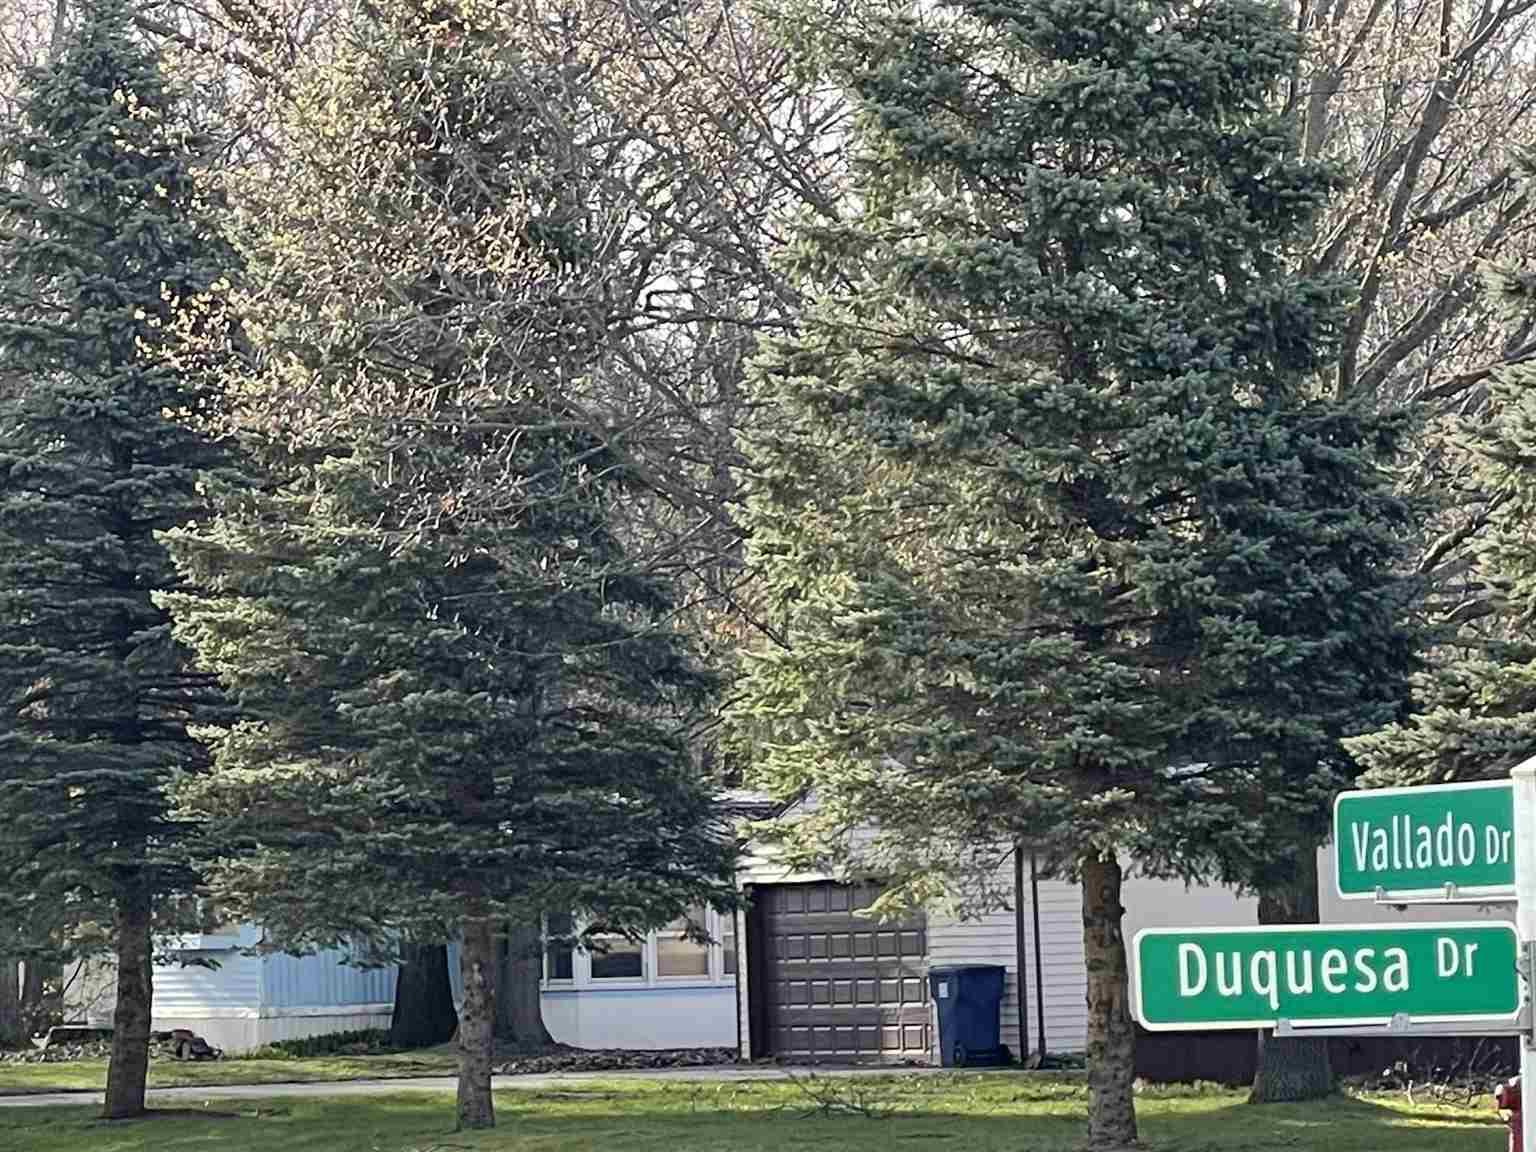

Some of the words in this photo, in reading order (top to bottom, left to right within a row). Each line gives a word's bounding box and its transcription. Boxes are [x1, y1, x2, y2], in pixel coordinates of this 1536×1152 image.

[1351, 811, 1476, 872] Vallado
[1485, 824, 1511, 865] Dr
[1178, 942, 1409, 1010] Duquesa
[1437, 937, 1479, 977] Dr
